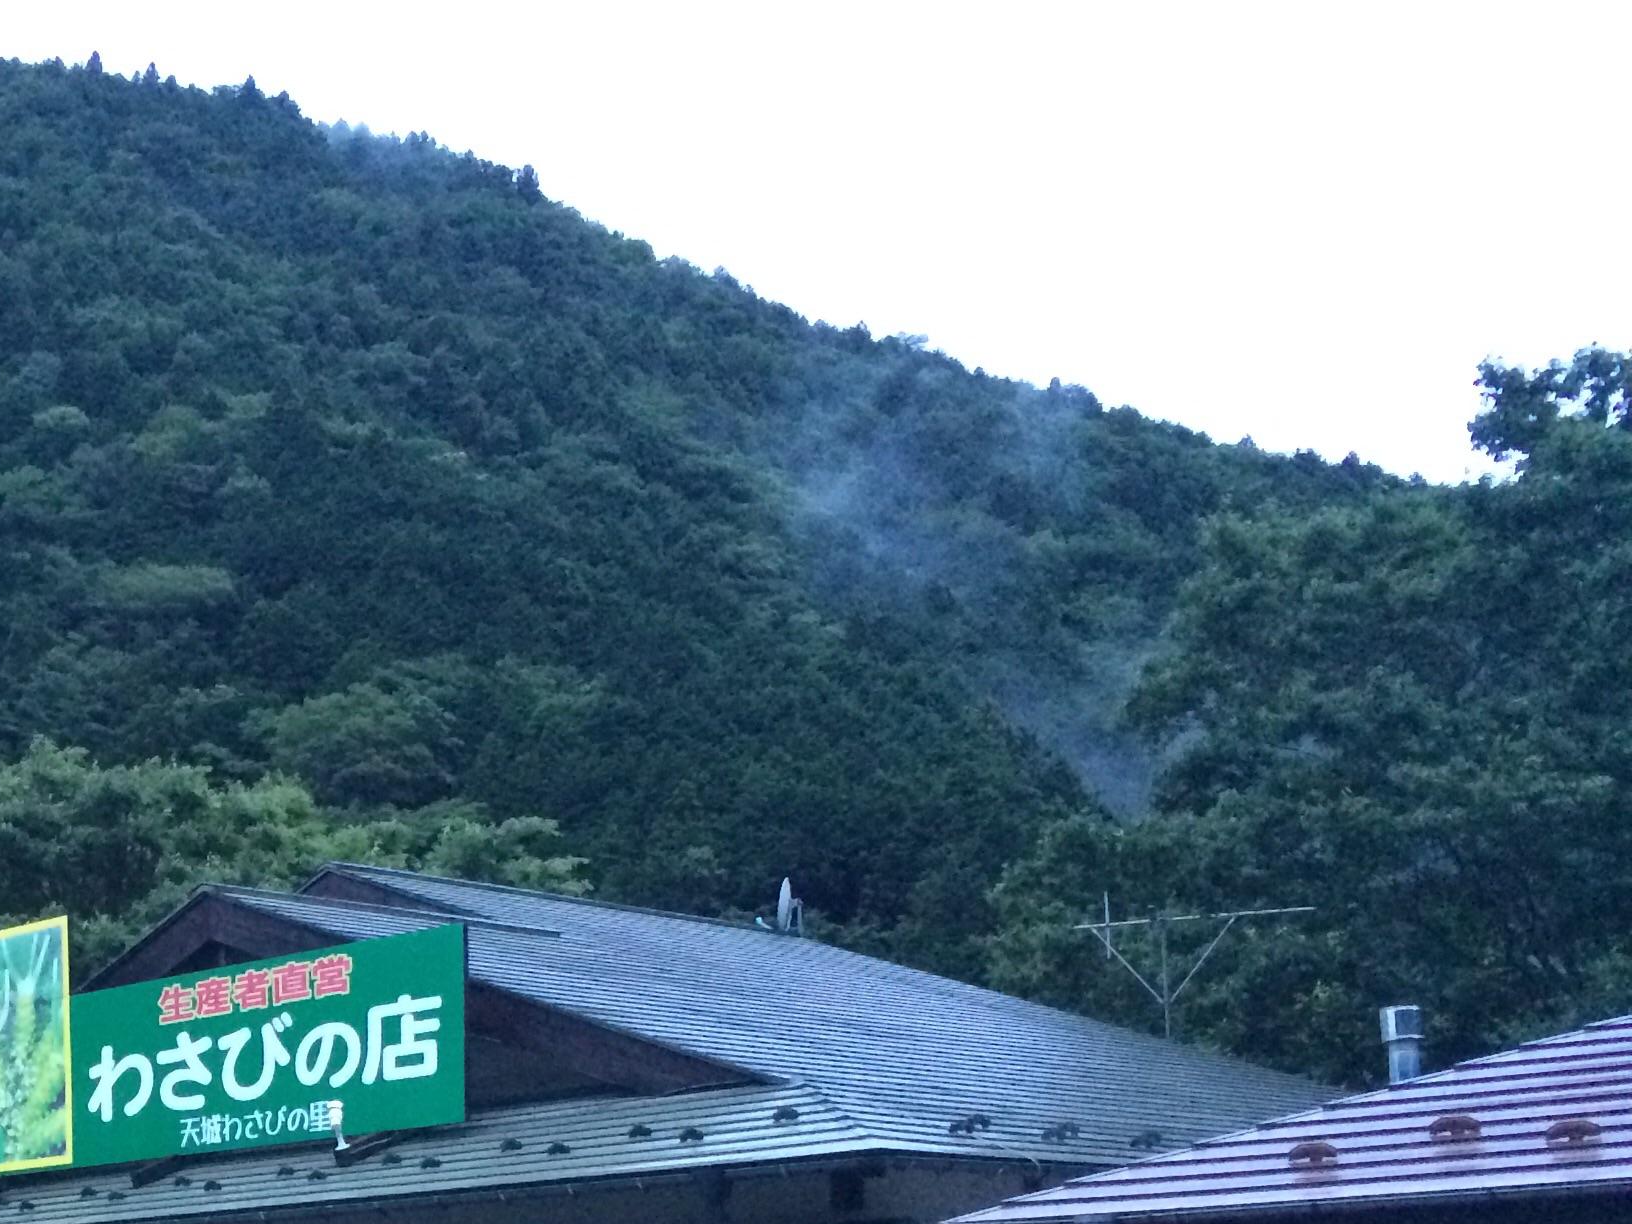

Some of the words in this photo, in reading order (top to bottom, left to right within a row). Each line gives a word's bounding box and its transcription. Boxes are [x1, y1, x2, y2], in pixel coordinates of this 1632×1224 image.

[158, 954, 353, 1025] 生産者直営
[87, 995, 443, 1123] わさびの店
[179, 1101, 335, 1148] 天城わさびの里
